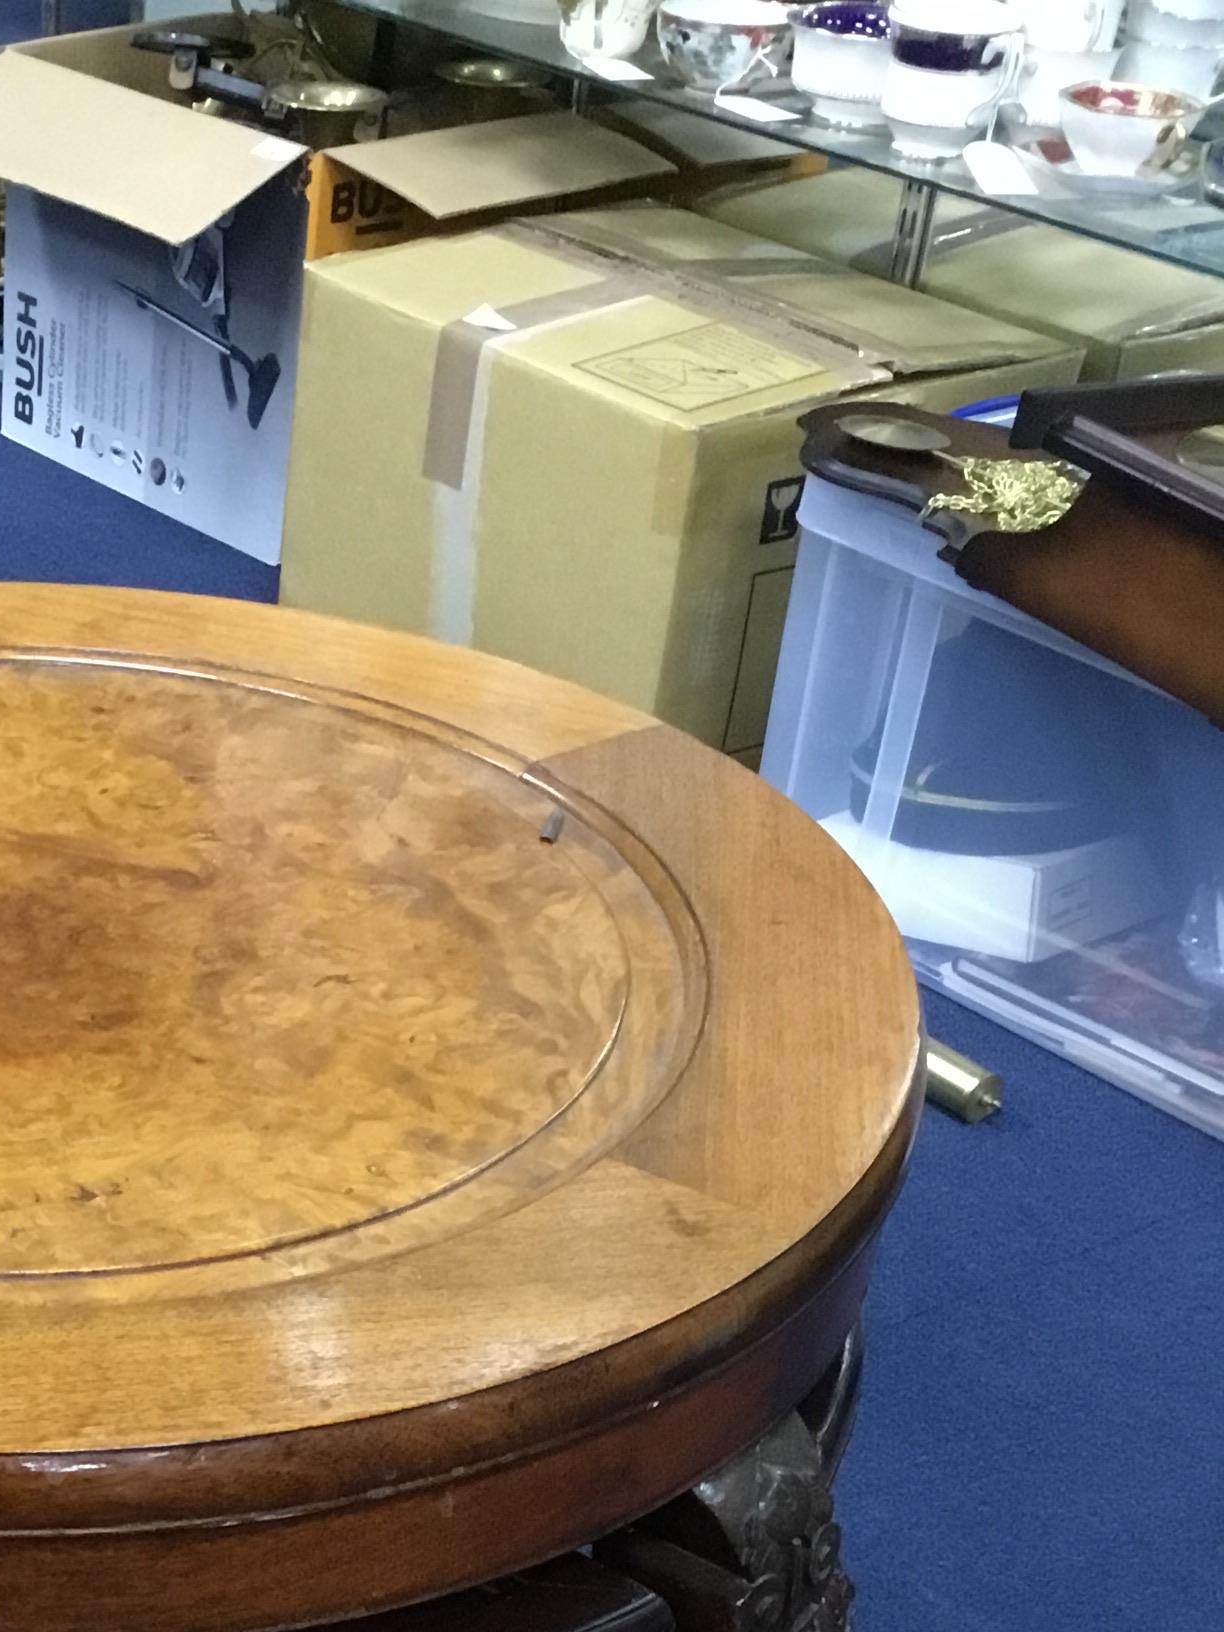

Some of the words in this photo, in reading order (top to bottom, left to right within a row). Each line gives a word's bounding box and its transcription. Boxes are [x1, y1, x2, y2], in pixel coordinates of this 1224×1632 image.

[14, 291, 38, 425] BUSH
[47, 318, 57, 379] Cylinder
[56, 321, 66, 378] Cleaner
[45, 382, 55, 435] Bagless
[53, 381, 63, 438] Vacuum
